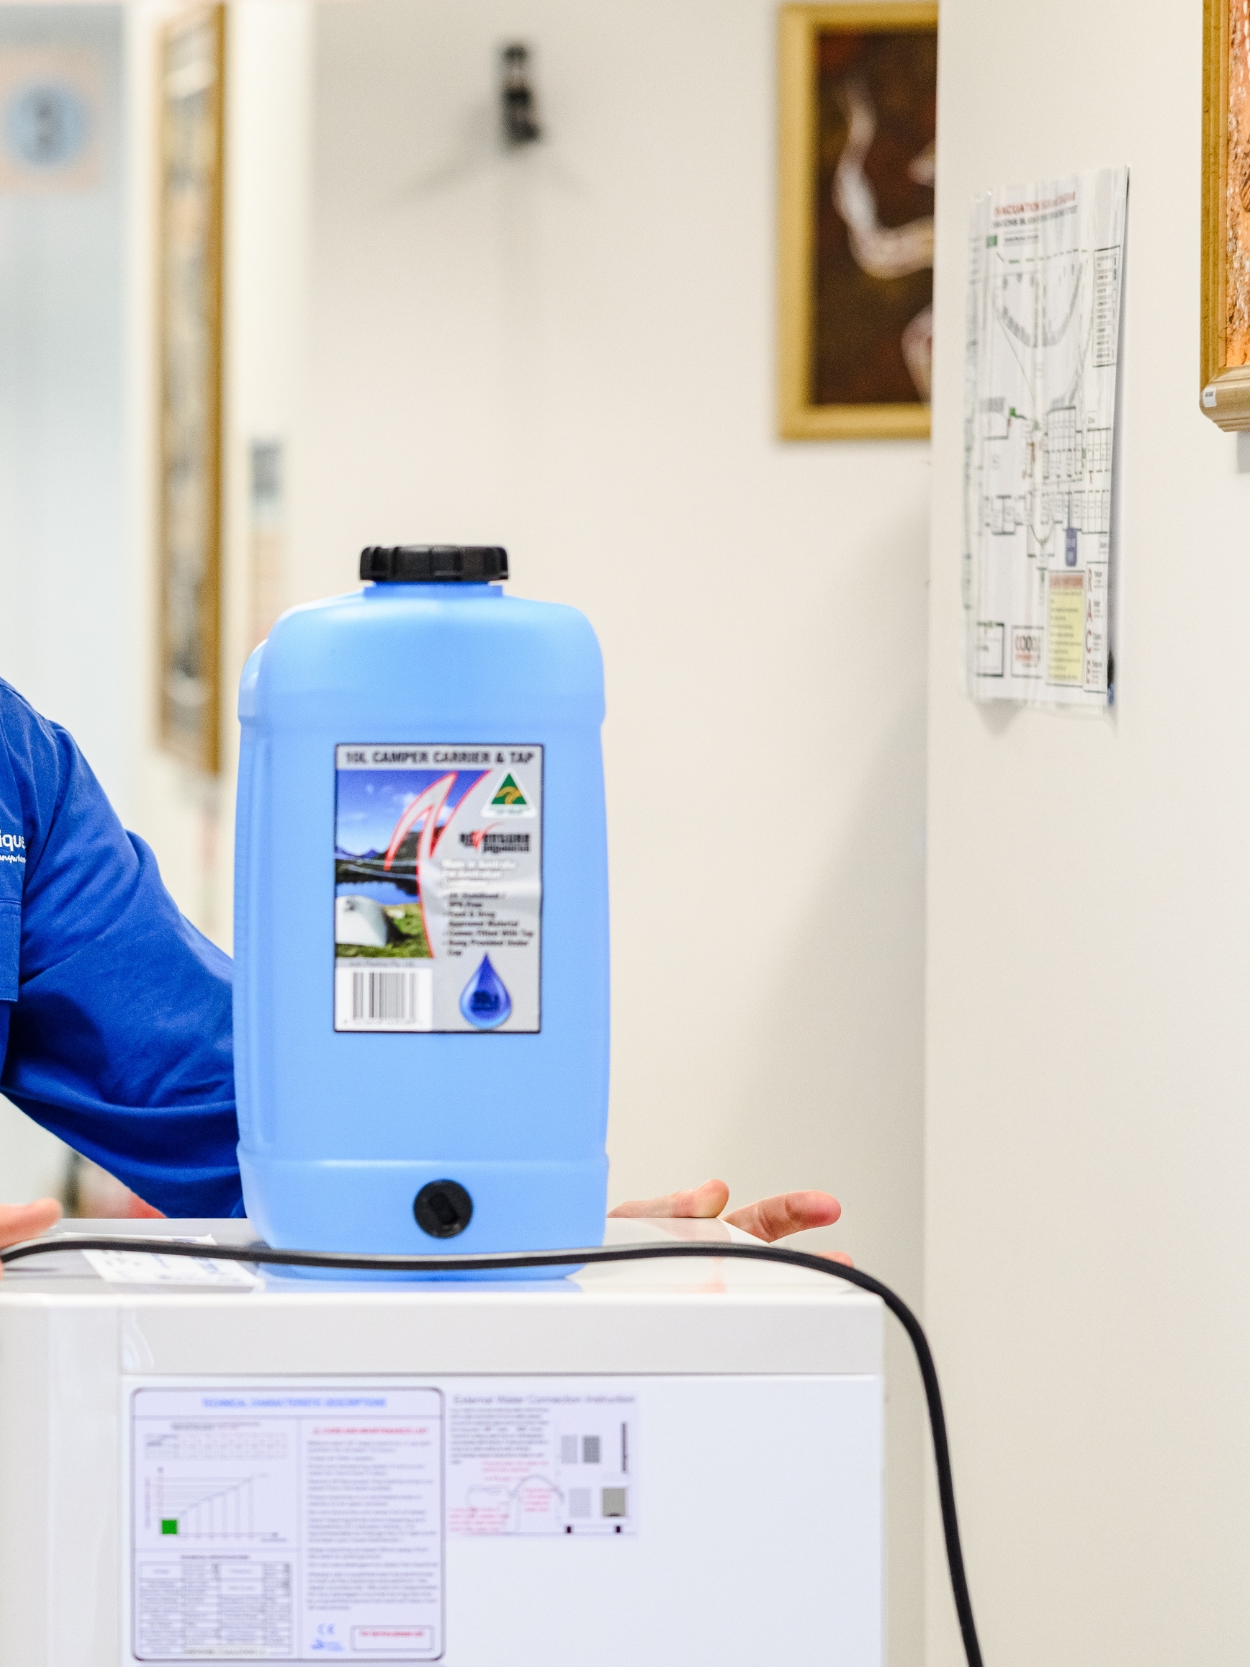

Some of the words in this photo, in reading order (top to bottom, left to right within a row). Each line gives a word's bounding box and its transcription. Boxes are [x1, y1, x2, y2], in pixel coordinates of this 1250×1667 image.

[346, 752, 368, 764] 10L
[372, 752, 429, 764] CAMPER
[433, 752, 491, 764] CARRIER
[496, 752, 505, 764] &
[510, 752, 534, 764] TAP
[448, 920, 484, 928] Approved
[453, 1395, 493, 1405] External
[496, 1395, 524, 1405] Water
[528, 1395, 583, 1405] Connection
